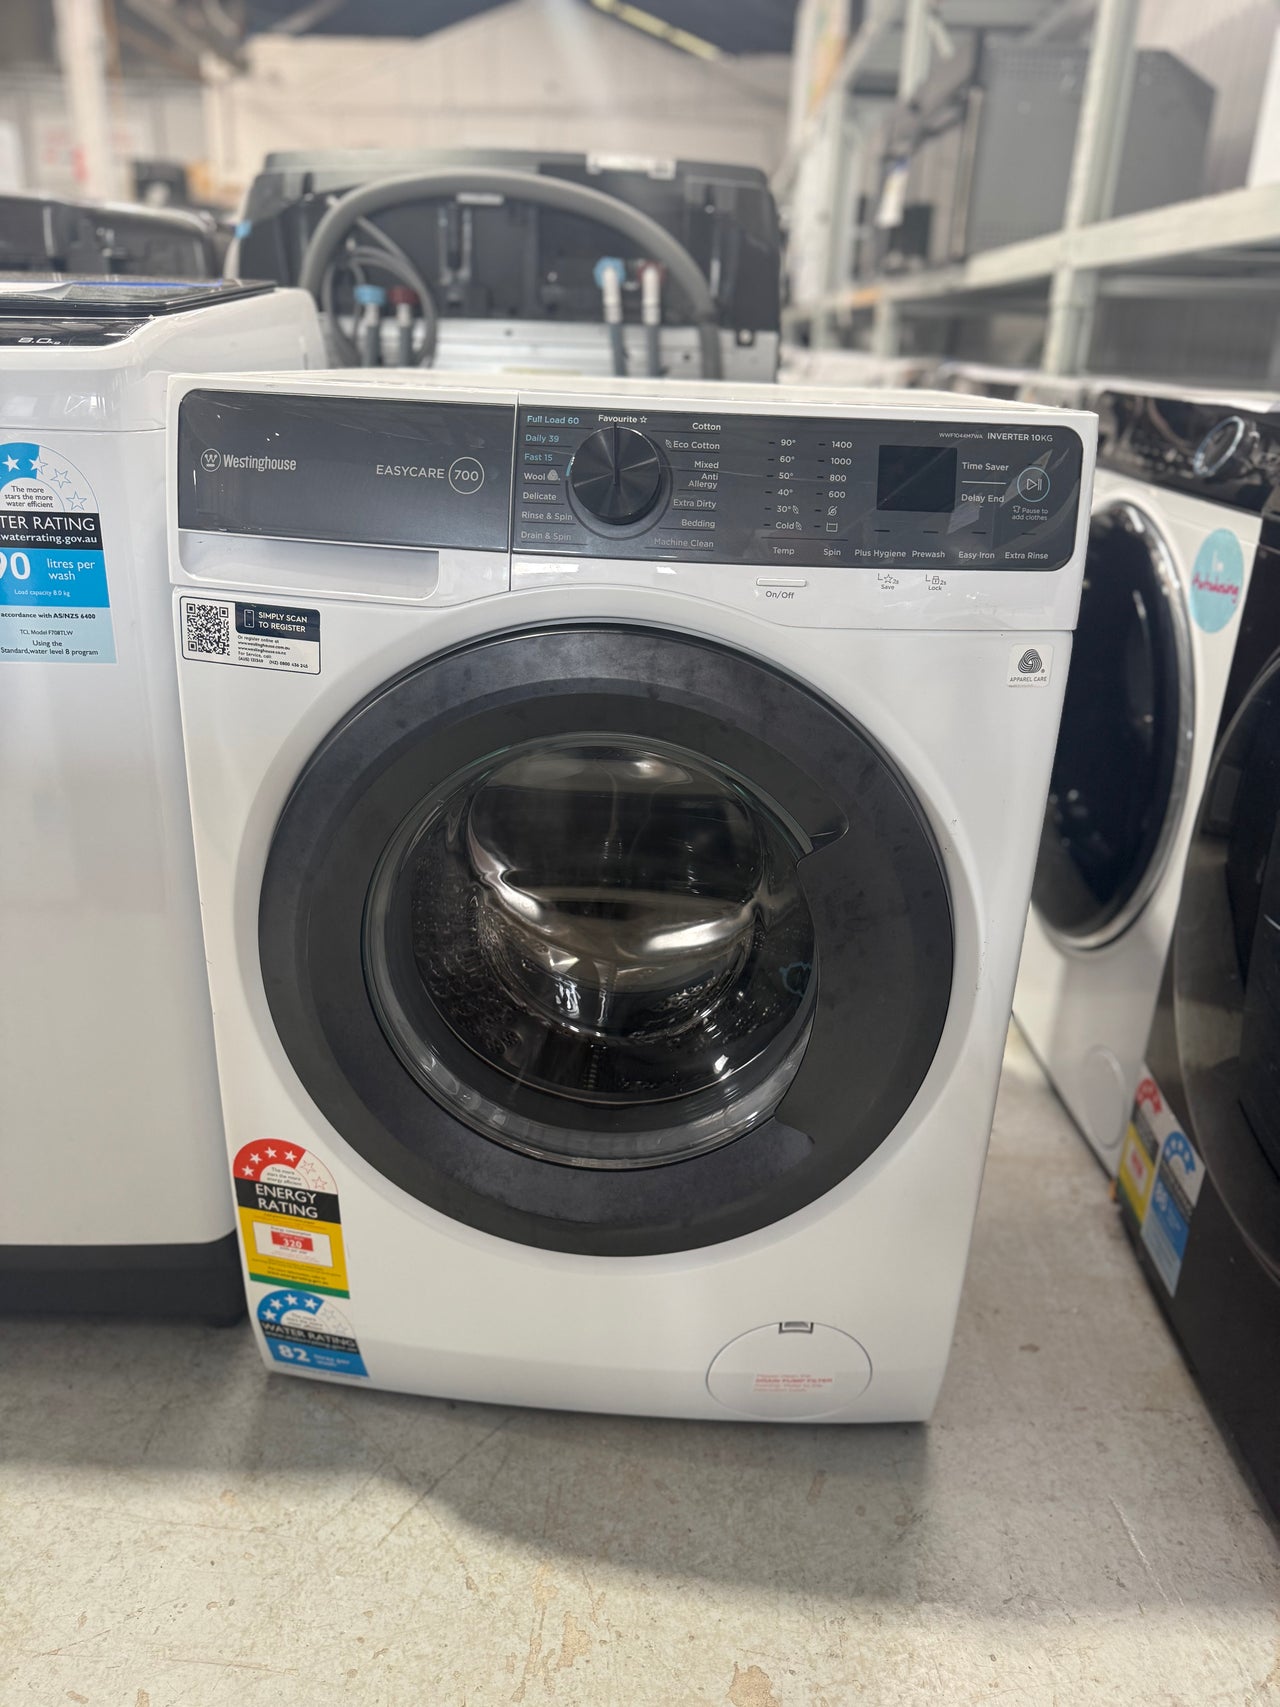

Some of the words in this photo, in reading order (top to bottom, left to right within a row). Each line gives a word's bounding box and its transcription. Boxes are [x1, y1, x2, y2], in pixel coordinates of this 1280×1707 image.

[527, 416, 542, 424] Full
[598, 415, 638, 424] Favourite
[526, 434, 546, 442] Daily
[988, 432, 1029, 440] INVERTER
[832, 440, 852, 448] 1400
[224, 454, 296, 472] Westinghouse
[694, 461, 719, 469] Mixed
[831, 458, 852, 466] 1000
[962, 462, 982, 470] Time
[986, 463, 1009, 471] Saver
[376, 464, 444, 479] EASYCARE
[454, 470, 479, 481] 700
[688, 480, 718, 489] Allergy
[523, 492, 556, 500] Delicate
[962, 494, 985, 502] Delay
[697, 500, 716, 508] Dirty
[522, 512, 544, 520] Rinse
[555, 513, 572, 522] Spin
[33, 517, 95, 531] RATING
[682, 519, 716, 528] Bedding
[776, 522, 794, 530] Cold
[521, 531, 542, 540] Drain
[554, 532, 572, 542] Spin
[654, 538, 688, 546] Machine
[690, 540, 714, 548] Clean
[773, 547, 794, 556] Temp
[824, 549, 841, 558] Spin
[874, 550, 906, 558] Hygiene
[1028, 552, 1048, 560] Rinse
[47, 558, 74, 568] litres
[78, 561, 96, 571] per
[48, 571, 76, 580] wash
[766, 590, 794, 600] On/Off
[258, 612, 284, 620] SIMPLY
[286, 614, 308, 623] SCAN
[271, 623, 306, 632] REGISTER
[256, 1184, 316, 1204] ENERGY
[258, 1198, 318, 1218] RATING
[284, 1238, 302, 1249] 320
[262, 1322, 306, 1338] WATER
[308, 1331, 356, 1346] RATING
[278, 1344, 310, 1362] 82
